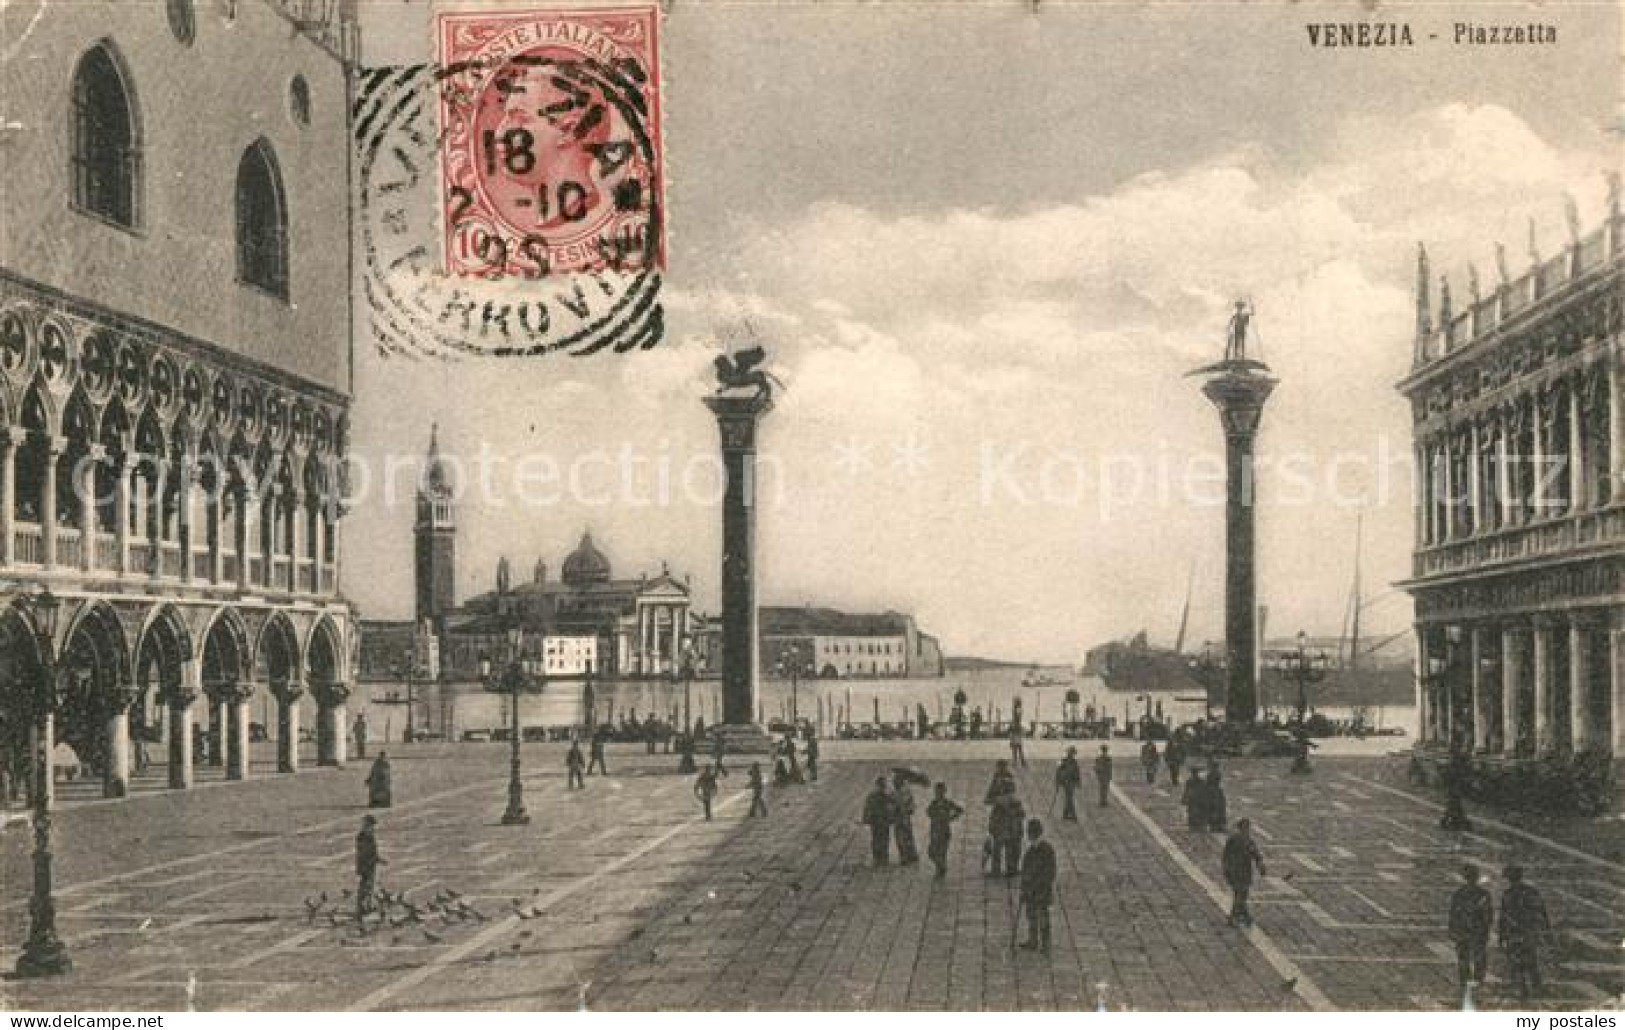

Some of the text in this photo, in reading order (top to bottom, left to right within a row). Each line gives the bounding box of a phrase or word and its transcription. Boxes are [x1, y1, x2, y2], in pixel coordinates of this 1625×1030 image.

[1306, 22, 1415, 47] VENEZIA
[1454, 22, 1557, 45] Piazzetta
[484, 128, 537, 176] 18
